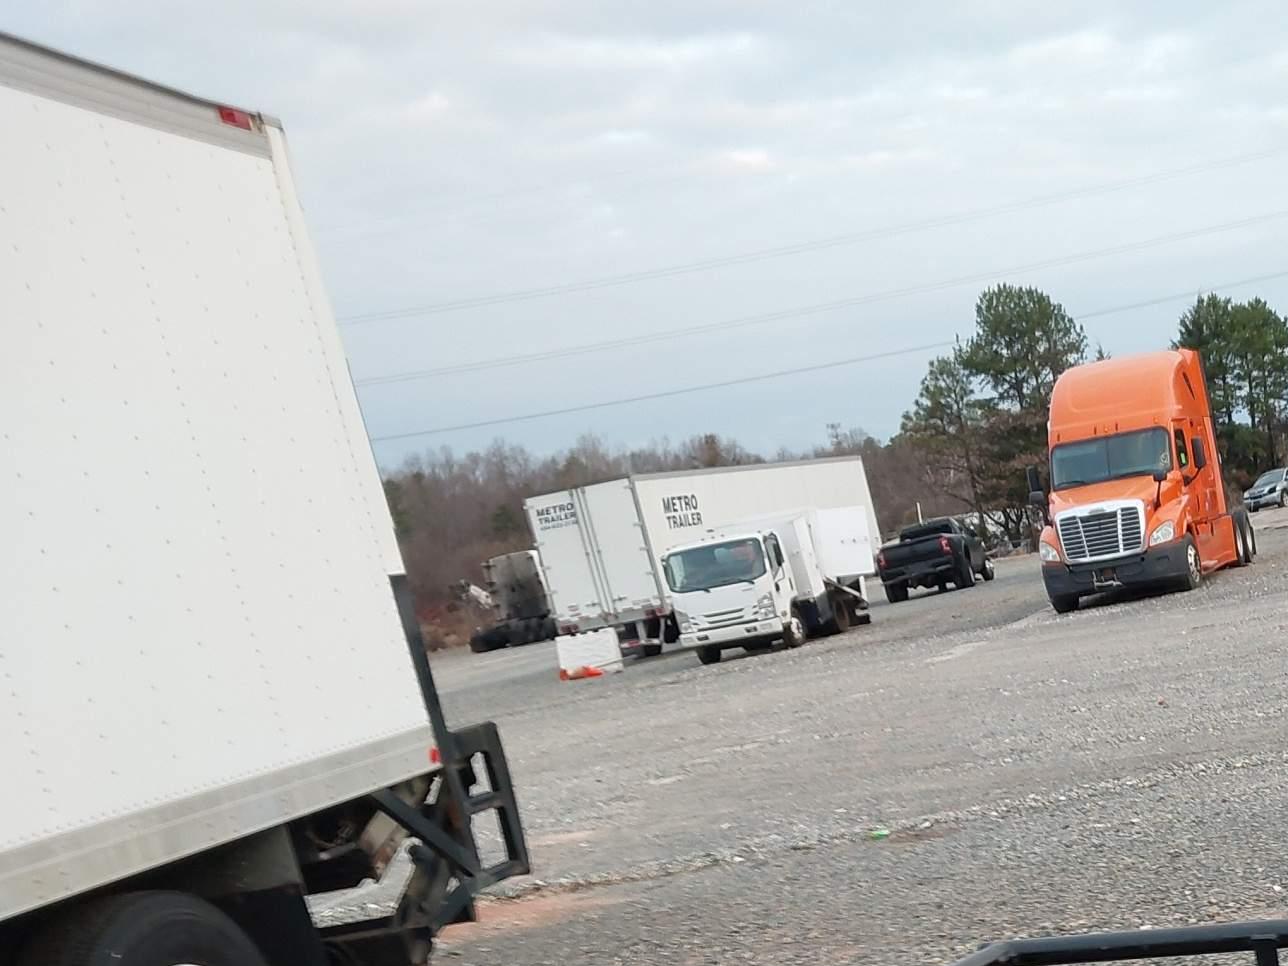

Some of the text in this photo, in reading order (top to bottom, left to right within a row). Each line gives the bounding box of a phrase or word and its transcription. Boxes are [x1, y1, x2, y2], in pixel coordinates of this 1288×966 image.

[536, 502, 574, 516] METRO
[662, 494, 698, 513] METRO
[666, 511, 703, 529] TRAILER
